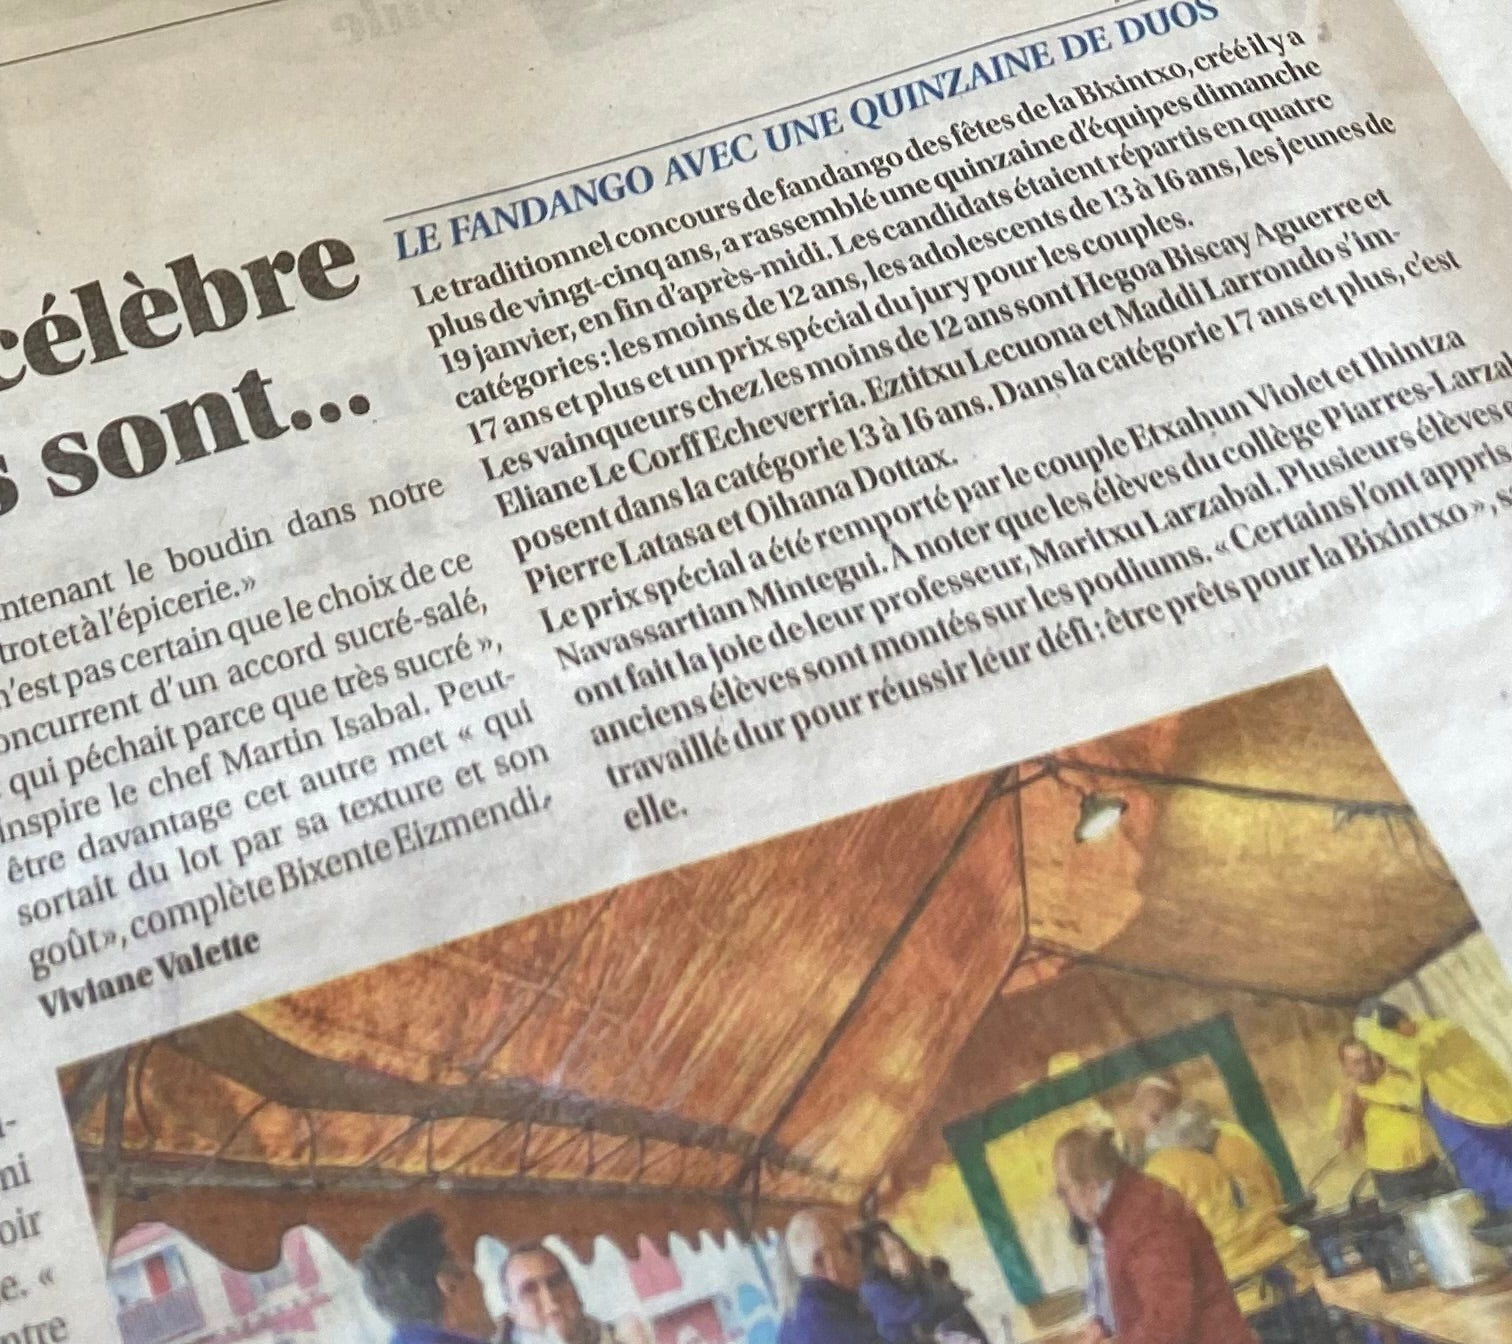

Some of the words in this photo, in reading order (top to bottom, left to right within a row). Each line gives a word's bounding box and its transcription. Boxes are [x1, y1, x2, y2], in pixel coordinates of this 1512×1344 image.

[394, 222, 442, 262] LE
[449, 165, 655, 247] FANDANGO
[664, 132, 758, 187] AVEC
[763, 106, 844, 153] UNE
[850, 41, 1055, 130] QUINZAINE
[1058, 25, 1113, 62] DE
[1073, 260, 1165, 306] Hegoa
[1165, 230, 1255, 273] Biscay
[1114, 288, 1205, 328] Maddi
[1205, 246, 1336, 302] Larrondo
[1360, 327, 1466, 378] Ihintza
[42, 366, 374, 500] sont...
[124, 558, 155, 585] le
[164, 526, 274, 573] boudin
[287, 501, 357, 537] dans
[368, 478, 445, 517] notre
[494, 474, 589, 518] Eliane
[524, 549, 620, 595] Pierre
[623, 794, 690, 833] elle.
[38, 967, 154, 1019] Viviane
[153, 931, 261, 981] Valette
